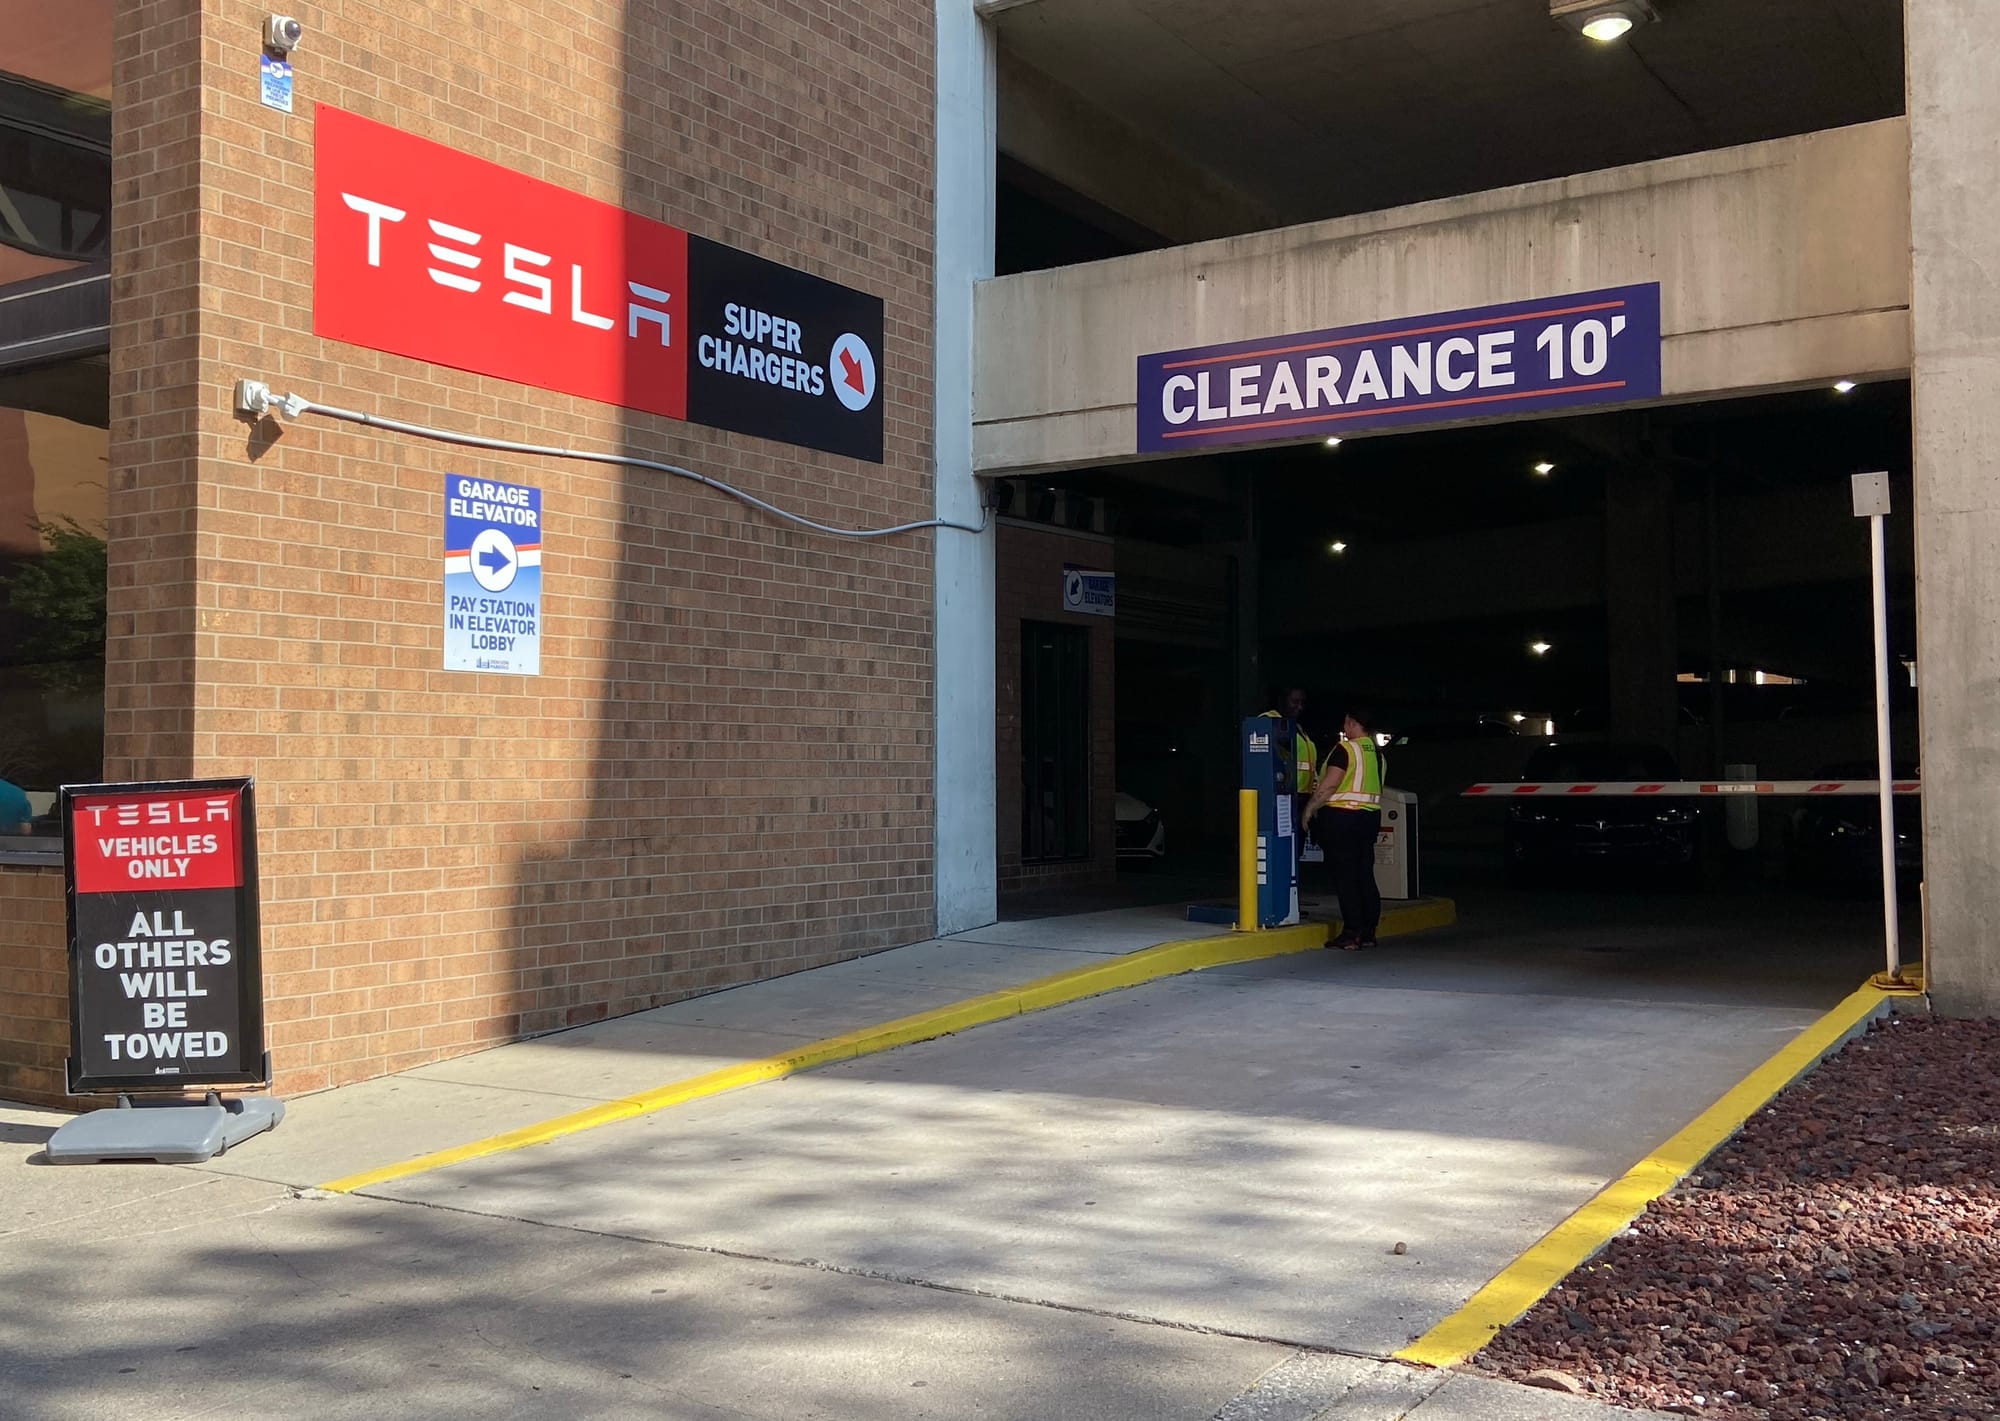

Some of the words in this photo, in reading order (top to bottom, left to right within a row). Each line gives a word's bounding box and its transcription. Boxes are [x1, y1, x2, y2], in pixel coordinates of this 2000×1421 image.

[340, 192, 670, 347] TESLA
[724, 302, 802, 354] SUPER
[698, 334, 825, 396] CHARGERS
[1162, 330, 1515, 425] CLEARANCE
[458, 479, 529, 506] GARAGE
[450, 498, 537, 527] ELEVATOR
[451, 596, 477, 612] PAY
[479, 598, 535, 618] STATION
[1085, 591, 1113, 606] ELEVATORS
[449, 614, 464, 629] IN
[468, 616, 535, 635] ELEVATOR
[471, 634, 516, 652] LOBBY
[85, 800, 229, 826] TESLA
[98, 834, 218, 857] VEHICLES
[128, 858, 191, 879] ONLY
[128, 910, 194, 938] ALL
[95, 940, 231, 969] OTHERS
[120, 971, 208, 998] WILL
[144, 1002, 187, 1028] BE
[105, 1031, 228, 1060] TOWED
